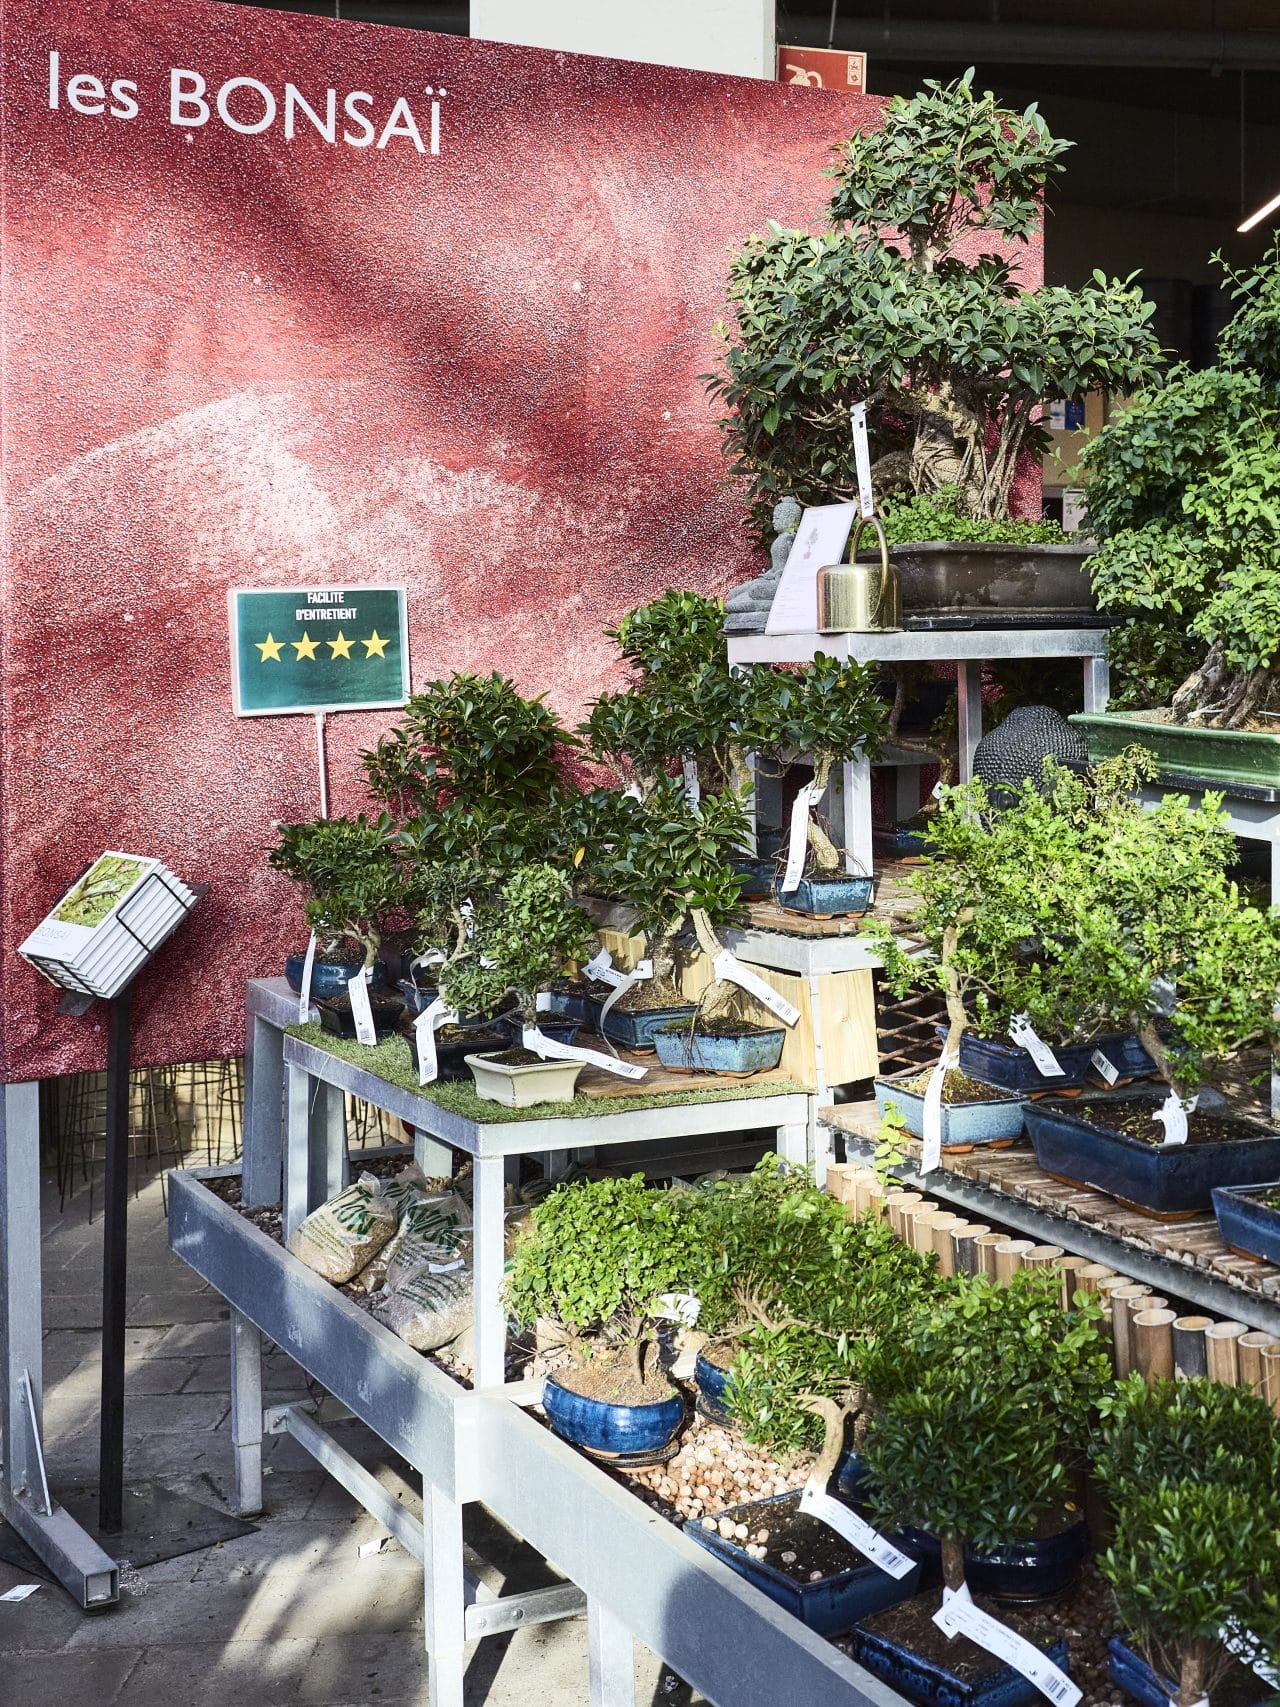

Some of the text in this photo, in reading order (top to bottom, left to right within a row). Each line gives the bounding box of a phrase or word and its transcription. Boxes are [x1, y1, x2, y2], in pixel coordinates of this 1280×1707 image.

[49, 50, 447, 155] les BONSAÏ
[307, 592, 345, 604] FACILITE
